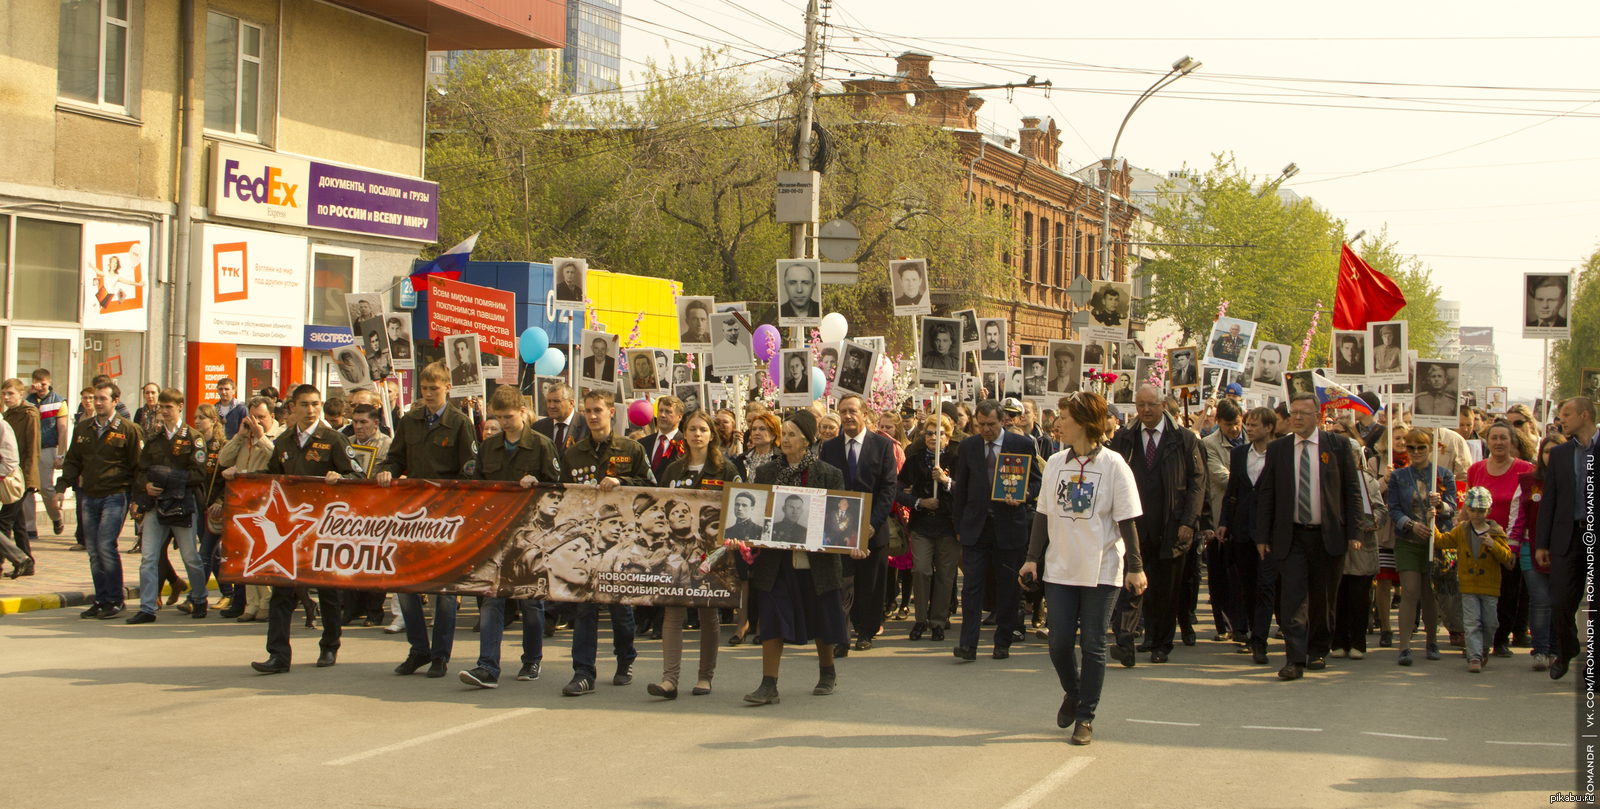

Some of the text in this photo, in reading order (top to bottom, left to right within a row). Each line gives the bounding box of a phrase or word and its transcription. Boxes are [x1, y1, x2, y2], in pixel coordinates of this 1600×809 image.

[223, 159, 298, 208] FedEx
[319, 176, 366, 194] ДОКУМЕНТЫ,
[369, 184, 401, 198] ПОСЫЛКИ
[409, 190, 430, 202] ГРУЗЫ
[267, 207, 287, 218] Express
[317, 204, 429, 229] ПО РОССИИ и ВСЕМУ МИРУ
[222, 266, 240, 278] ТТК
[254, 263, 275, 273] Взгляни
[265, 279, 284, 288] другим
[284, 280, 298, 288] углом
[432, 286, 508, 312] Всем миром помяним,
[436, 300, 505, 322] поклонимся павшим
[430, 321, 451, 334] Слава
[490, 335, 514, 348] Слава
[433, 311, 510, 336] защитникам отечества
[204, 364, 225, 372] ПОЛНЫЙ
[318, 502, 462, 545] Бессмертный
[314, 542, 397, 573] ПОЛК
[598, 572, 673, 584] НОВОСИБИРСК
[598, 584, 731, 598] НОВОСИБИРСКАЯ ОБЛАСТЬ
